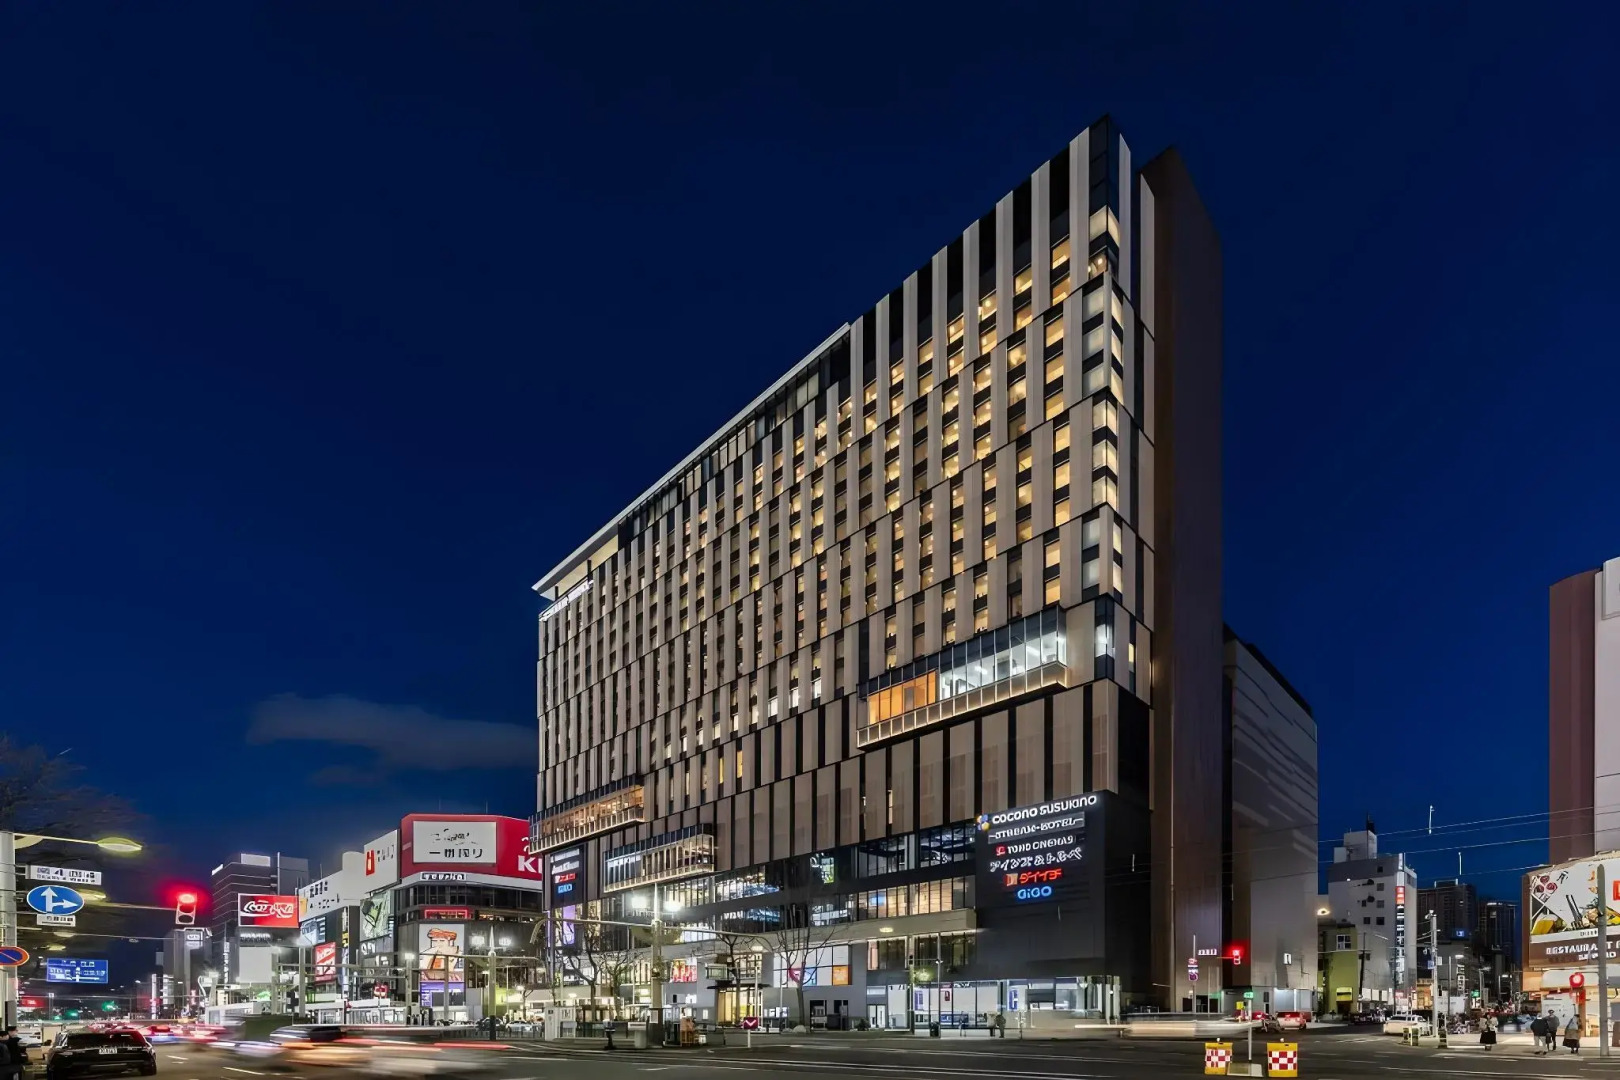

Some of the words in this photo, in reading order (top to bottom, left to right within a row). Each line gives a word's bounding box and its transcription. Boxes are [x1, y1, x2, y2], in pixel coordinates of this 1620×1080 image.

[992, 807, 1038, 825] COCONO
[1039, 795, 1097, 816] SUSUKINO
[1546, 941, 1615, 955] RESTAURAT
